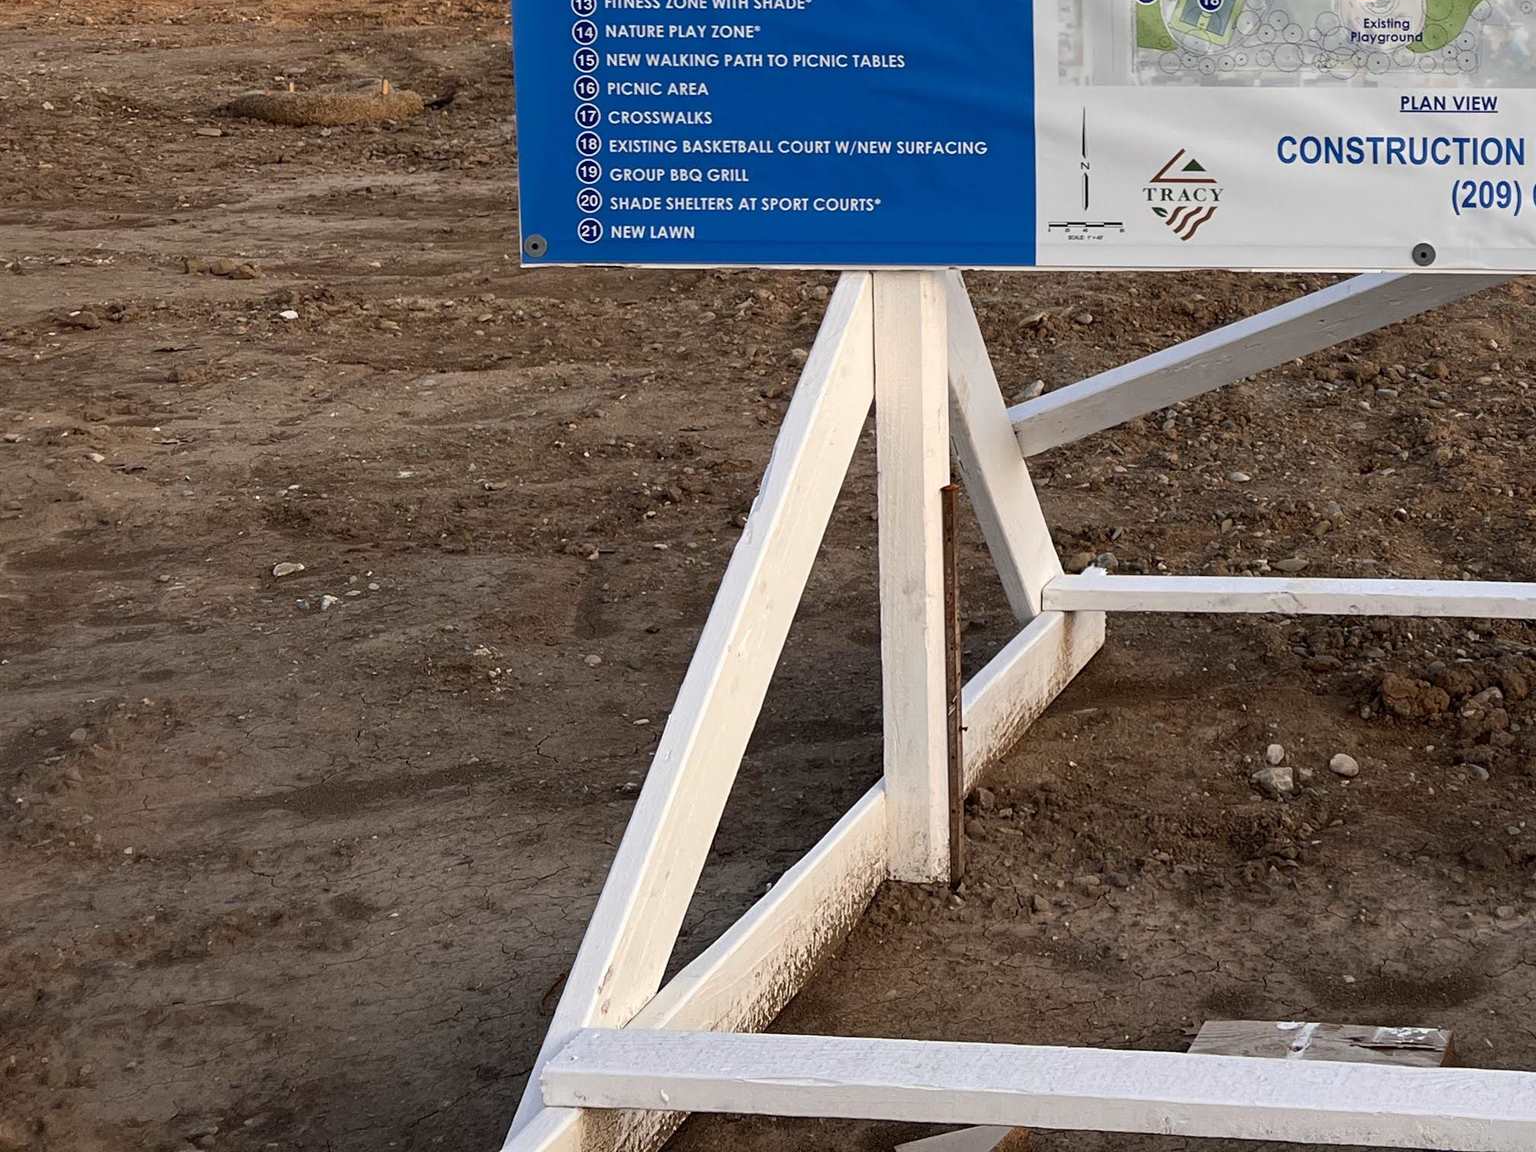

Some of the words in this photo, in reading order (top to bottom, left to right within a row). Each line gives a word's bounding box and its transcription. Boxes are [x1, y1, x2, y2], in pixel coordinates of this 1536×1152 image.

[606, 25, 664, 37] NATURE
[669, 25, 706, 37] PLAY
[1363, 19, 1410, 30] Existing
[1350, 32, 1423, 44] Playground
[607, 54, 641, 66] NEW
[646, 54, 719, 66] WALKING
[725, 54, 762, 66] PATH
[767, 54, 788, 67] TO
[793, 55, 847, 67] PICNIC
[852, 55, 905, 67] TABLES
[608, 83, 662, 95] PICNIC
[668, 83, 708, 95] AREA
[1401, 96, 1446, 111] PLAN
[1453, 96, 1498, 111] VIEW
[608, 111, 712, 124] CROSSWALKS
[610, 140, 677, 153] EXISTING
[683, 140, 773, 153] BASKETBALL
[778, 141, 830, 153] COURT
[835, 141, 891, 155] W/NEW
[897, 141, 987, 154] SURFACING
[1277, 136, 1525, 166] CONSTRUCTION
[610, 169, 665, 181] GROUP
[671, 169, 702, 182] BBQ
[707, 169, 748, 181] GRILL
[1143, 188, 1223, 202] TRACY
[1451, 180, 1519, 216] (209)
[611, 197, 661, 209] SHADE
[666, 197, 733, 210] SHELTERS
[738, 198, 757, 210] AT
[762, 198, 808, 210] SPORT
[611, 226, 645, 238] NEW
[651, 226, 694, 238] LAWN
